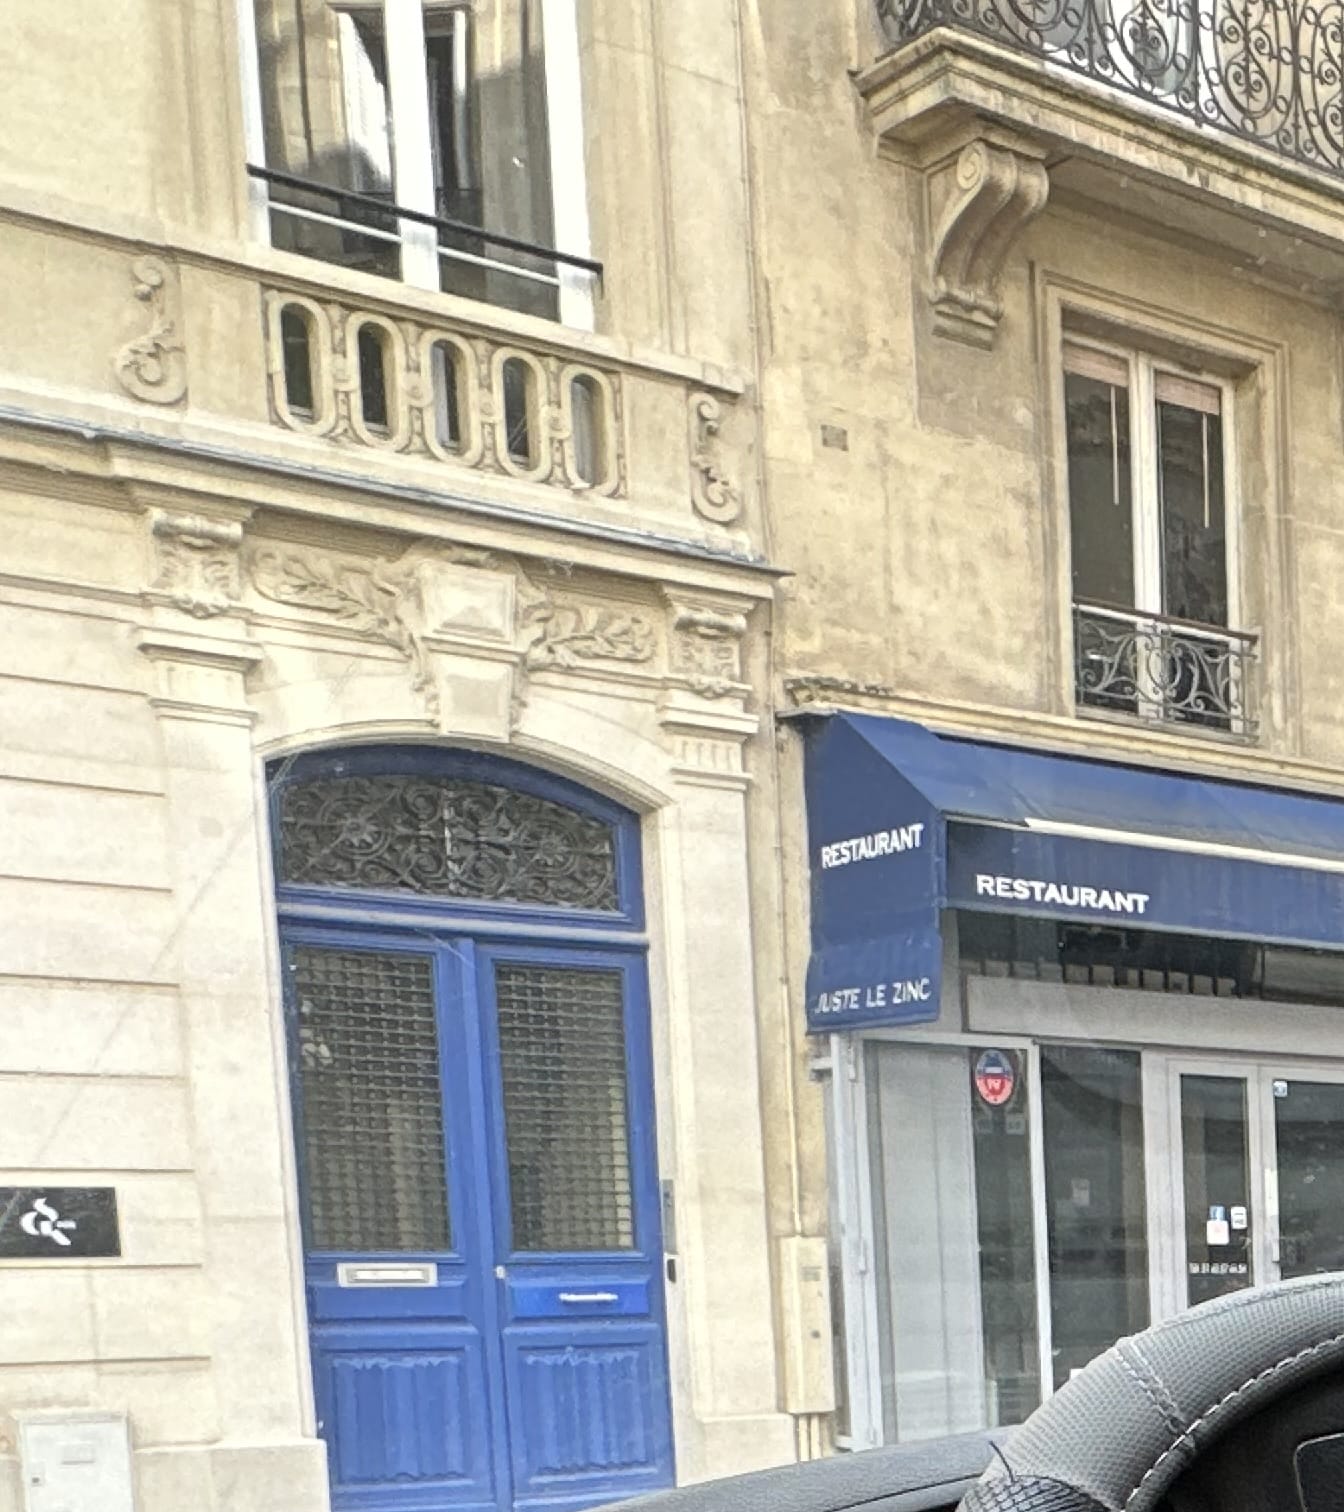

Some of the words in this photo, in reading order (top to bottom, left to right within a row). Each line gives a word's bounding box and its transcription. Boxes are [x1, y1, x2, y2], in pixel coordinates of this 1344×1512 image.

[821, 822, 924, 869] RESTAURANT
[976, 874, 1150, 914] RESTAURANT
[814, 987, 861, 1015] JUSTE
[865, 983, 887, 1009] LE
[892, 976, 932, 1005] ZINC
